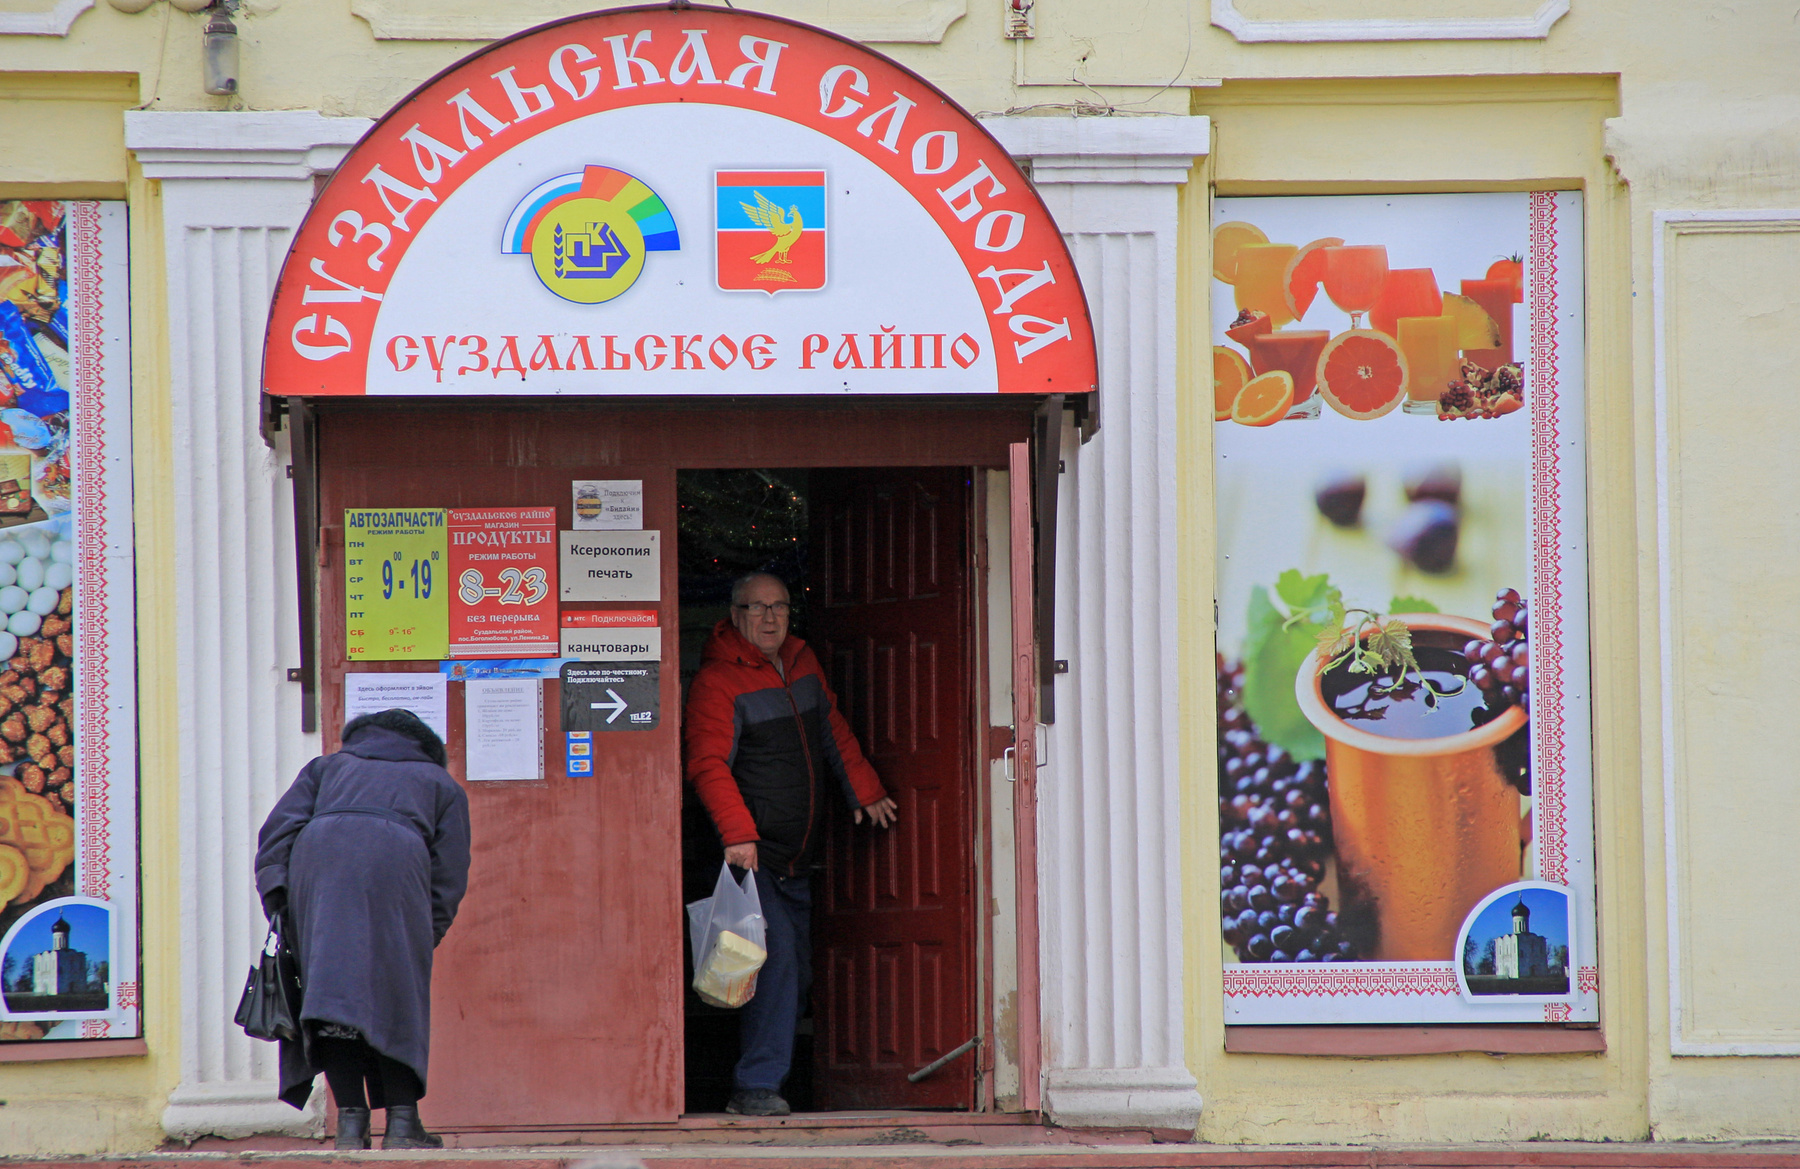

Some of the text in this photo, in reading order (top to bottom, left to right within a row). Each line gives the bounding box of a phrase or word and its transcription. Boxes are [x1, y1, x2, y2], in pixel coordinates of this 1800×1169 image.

[291, 29, 1072, 364] СУЗДАЛЬСКАЯ СЛОБОДА
[385, 324, 980, 383] СУЗДАЛЬСКОЕ РАЙПО
[604, 489, 641, 497] Подключим
[349, 511, 444, 528] АВТОЗАПЧАСТИ
[453, 509, 551, 522] СУЗДАЛЬСКОЕ РАЙПО
[484, 521, 520, 529] МАГАЗИН
[453, 530, 551, 548] ПРОДУКТЫ
[570, 544, 651, 558] Ксерокопия
[468, 552, 536, 561] РЕЖИМ РАБОТЫ
[587, 568, 633, 580] печать
[591, 614, 655, 624] Подключайся!
[473, 628, 513, 636] Суздальский
[567, 642, 650, 655] канцтовары
[566, 668, 588, 677] Здесь
[601, 669, 649, 678] по-честному.
[567, 676, 625, 684] Подключайтесь
[375, 685, 410, 693] оформляют
[629, 711, 652, 721] TELE2
